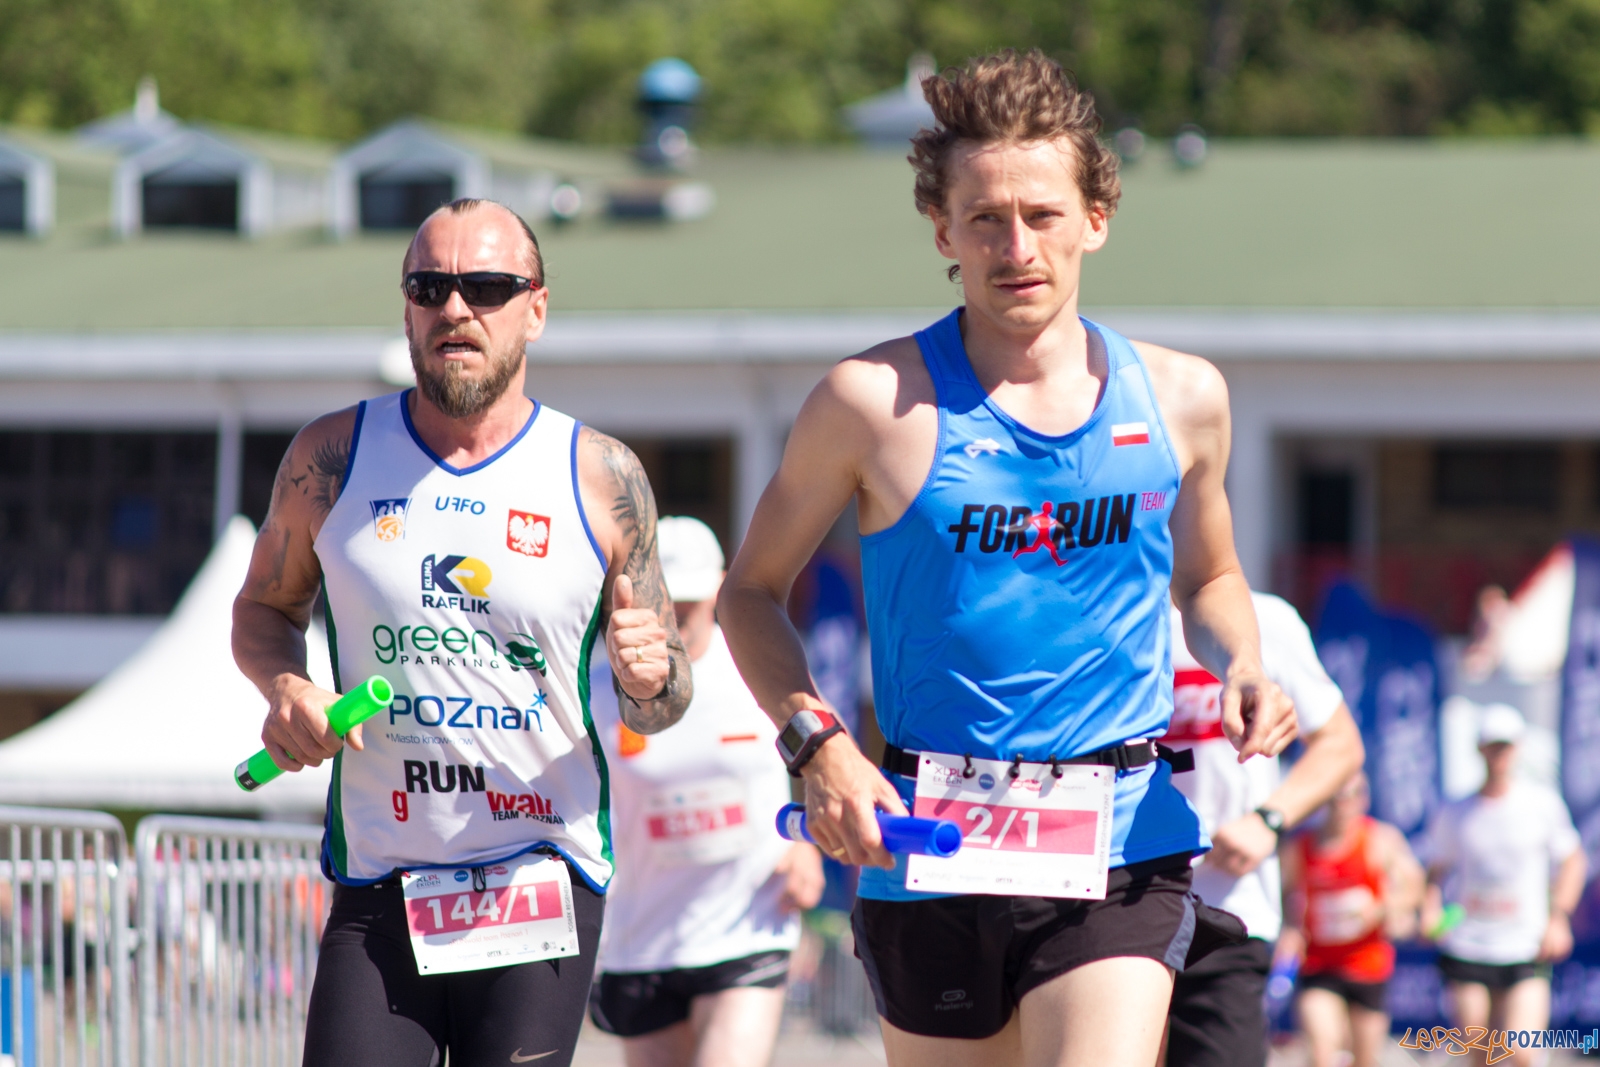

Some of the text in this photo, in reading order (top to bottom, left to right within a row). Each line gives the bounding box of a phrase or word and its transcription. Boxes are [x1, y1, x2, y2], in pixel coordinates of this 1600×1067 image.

[1140, 490, 1167, 511] TEAM
[948, 493, 1136, 554] FOR RUN
[424, 559, 433, 589] KLIMA
[421, 593, 491, 615] RAFLIK
[372, 624, 498, 664] green
[400, 654, 500, 669] PARKING
[932, 775, 963, 785] EKIDEN
[491, 810, 519, 822] TEAM
[963, 806, 1040, 850] 2/1
[416, 879, 441, 888] EKIDEN
[426, 885, 539, 930] 144/1
